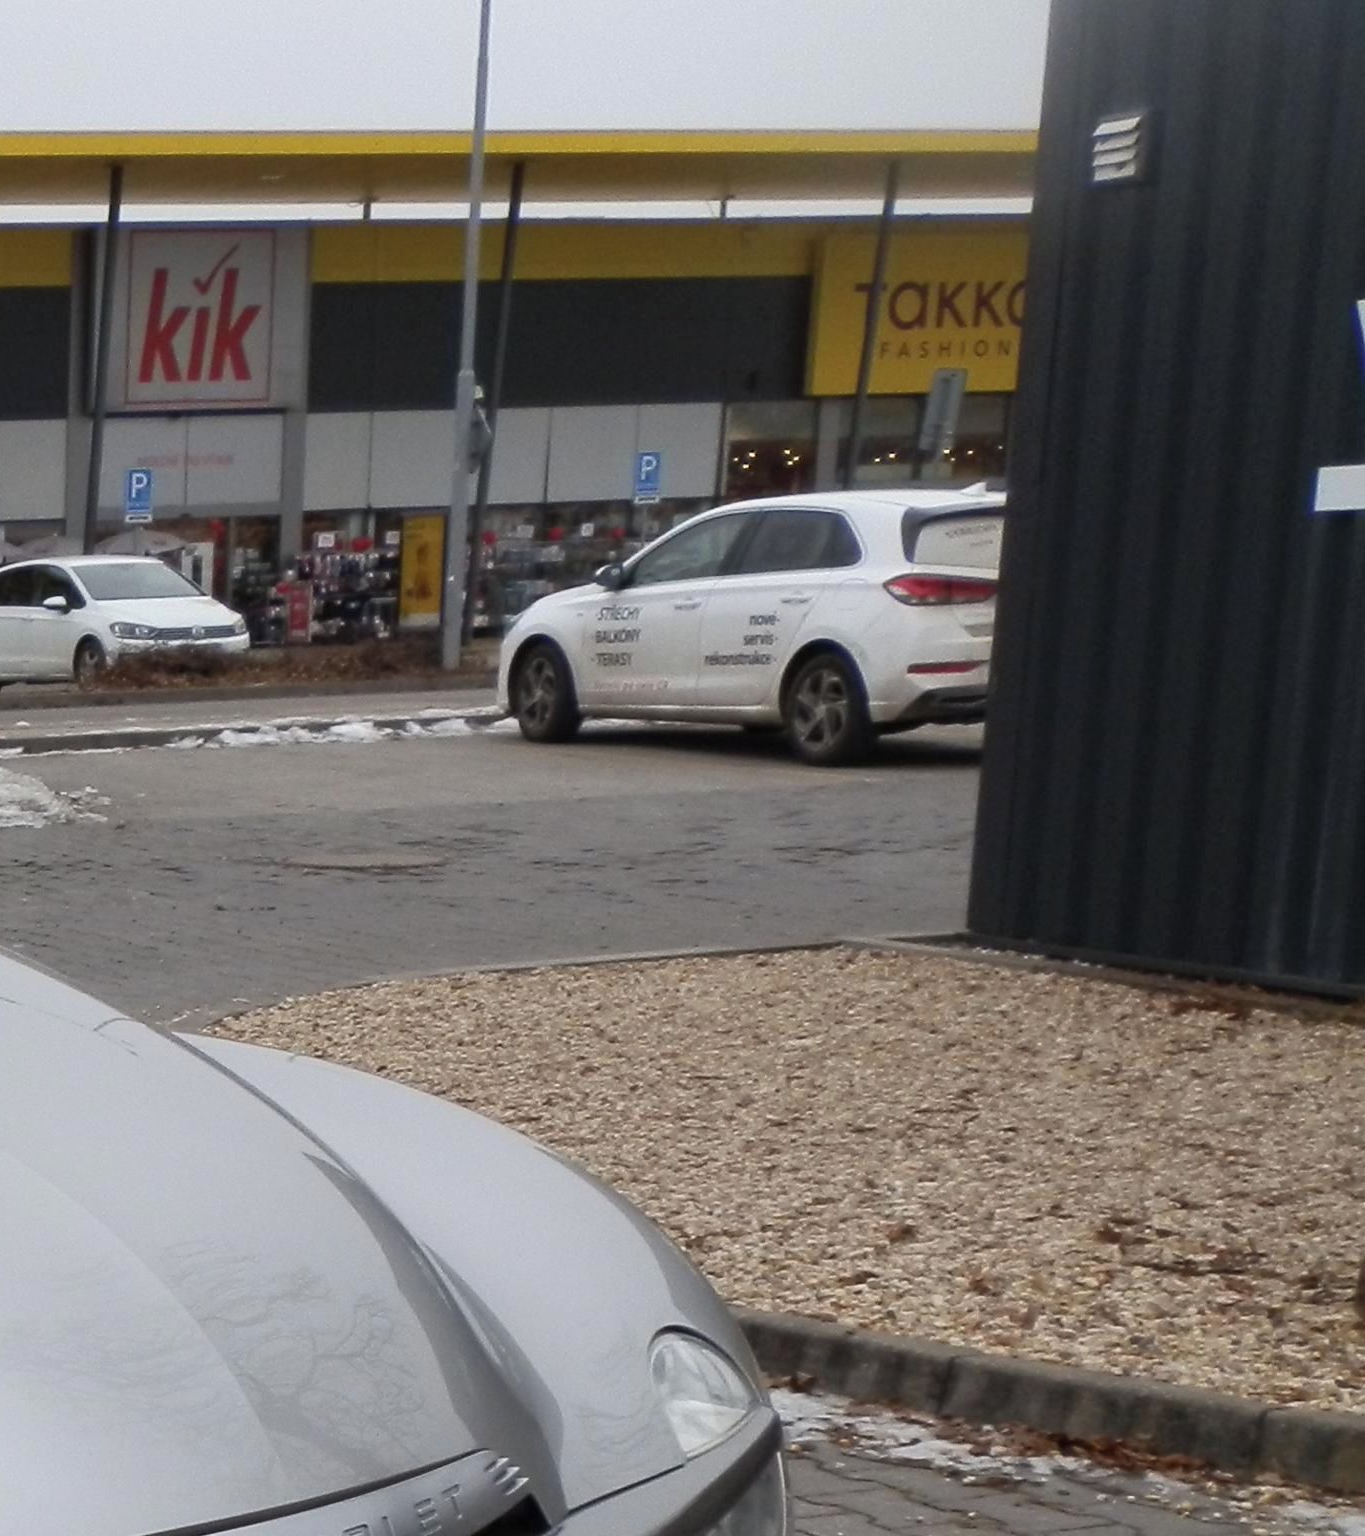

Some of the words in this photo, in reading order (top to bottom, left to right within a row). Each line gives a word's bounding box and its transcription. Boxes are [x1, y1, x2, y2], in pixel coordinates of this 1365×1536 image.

[880, 339, 1011, 358] FASHION
[641, 455, 657, 481] P
[132, 472, 149, 499] P
